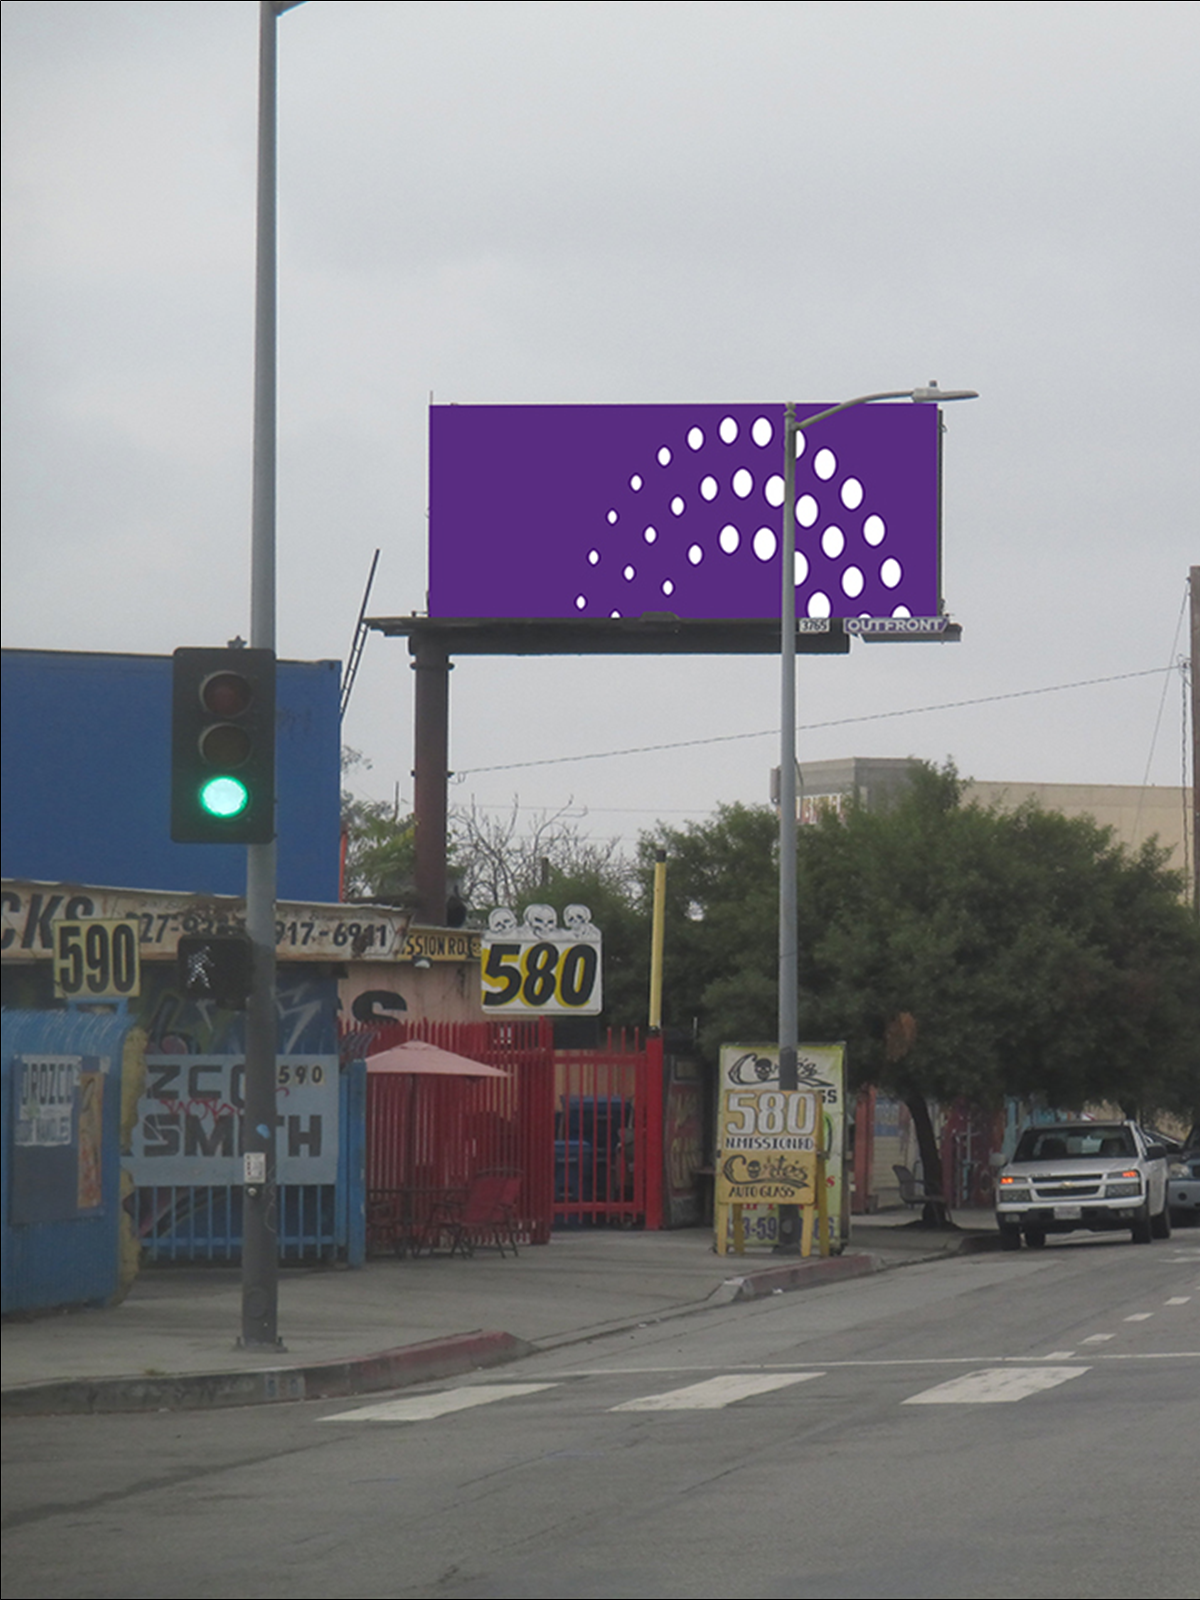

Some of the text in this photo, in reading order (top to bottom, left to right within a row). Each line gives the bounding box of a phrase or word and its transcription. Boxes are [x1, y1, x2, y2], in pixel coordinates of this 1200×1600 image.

[847, 619, 943, 631] OUTFRONT
[59, 924, 135, 994] 590
[401, 934, 446, 955] SSION
[484, 942, 598, 1006] 580
[278, 1066, 323, 1084] 590
[727, 1091, 816, 1135] 580
[143, 1115, 322, 1157] SMIH
[759, 1186, 796, 1197] GLASS
